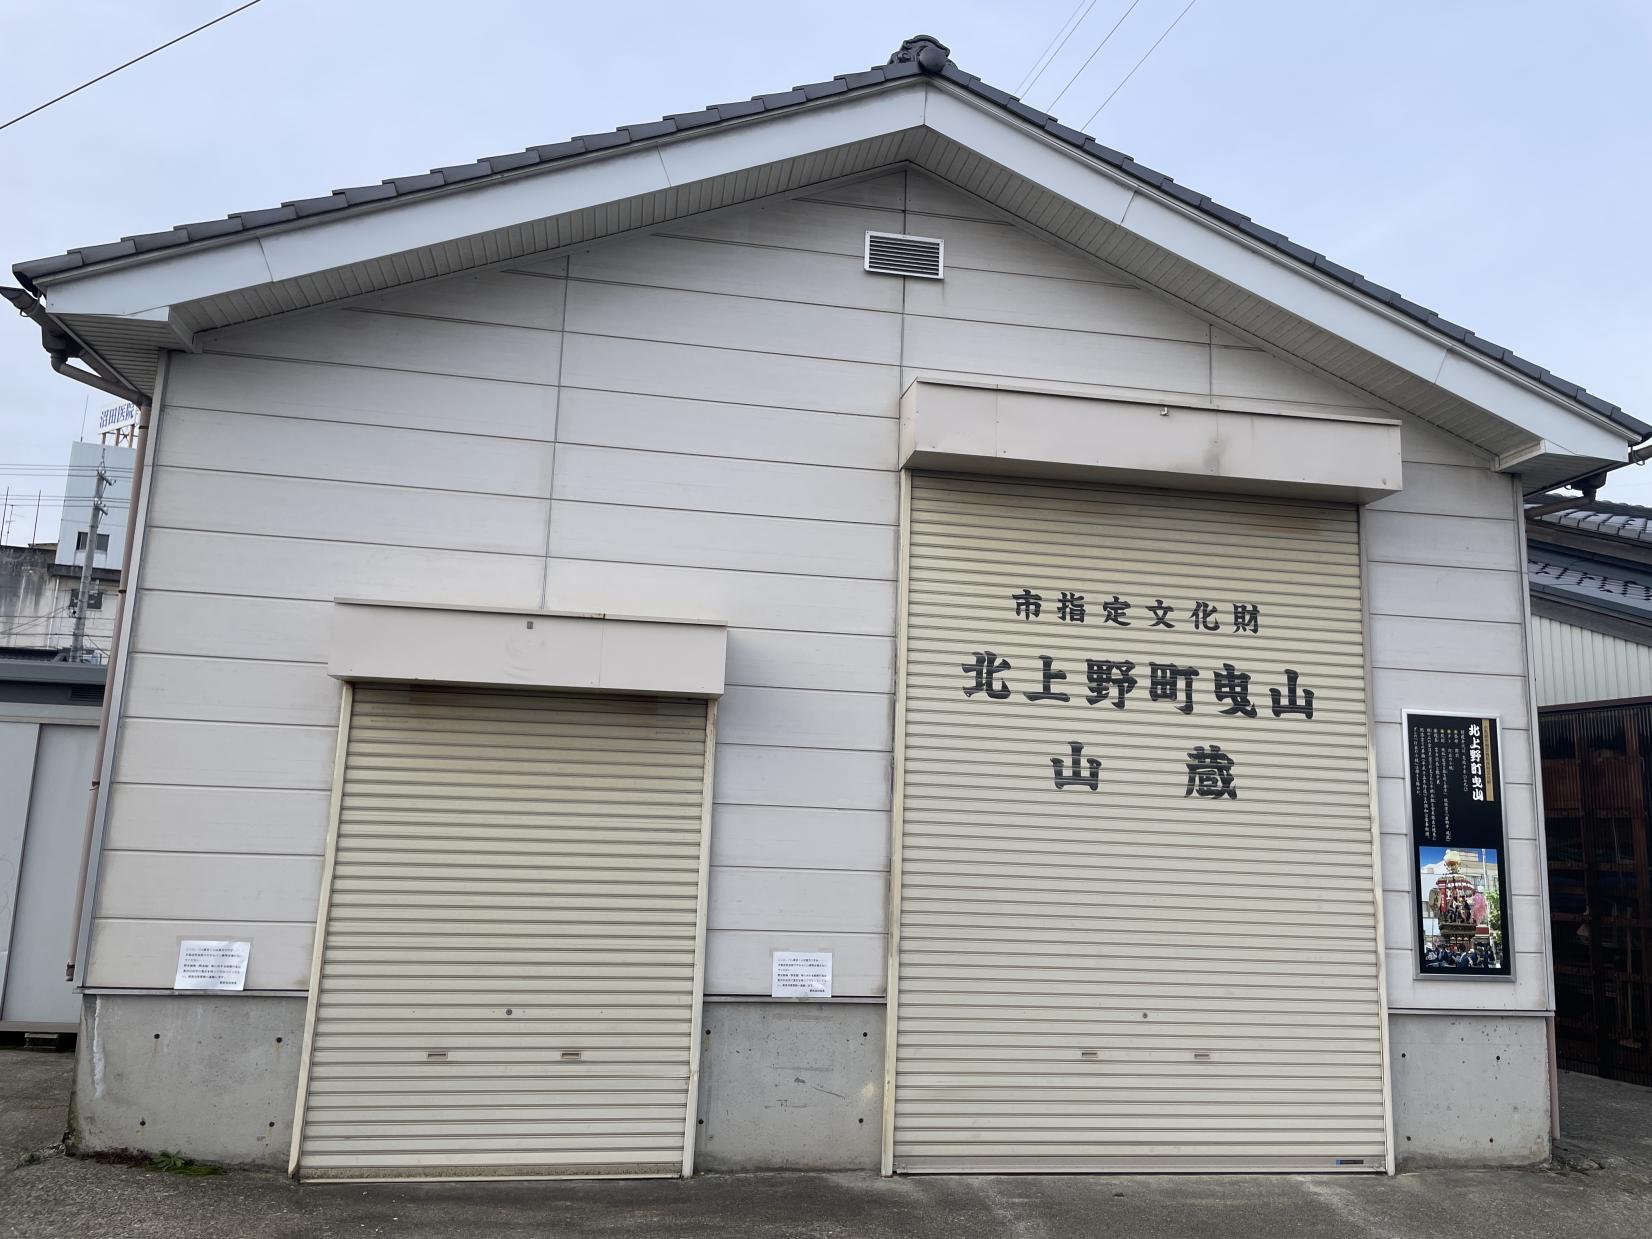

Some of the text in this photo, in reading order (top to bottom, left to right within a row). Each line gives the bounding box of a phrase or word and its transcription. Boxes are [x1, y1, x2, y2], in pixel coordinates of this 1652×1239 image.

[1012, 589, 1261, 634] 市指定文化財
[961, 651, 1315, 719] 北上野町曳山
[1469, 724, 1484, 801] 北上野町曳山
